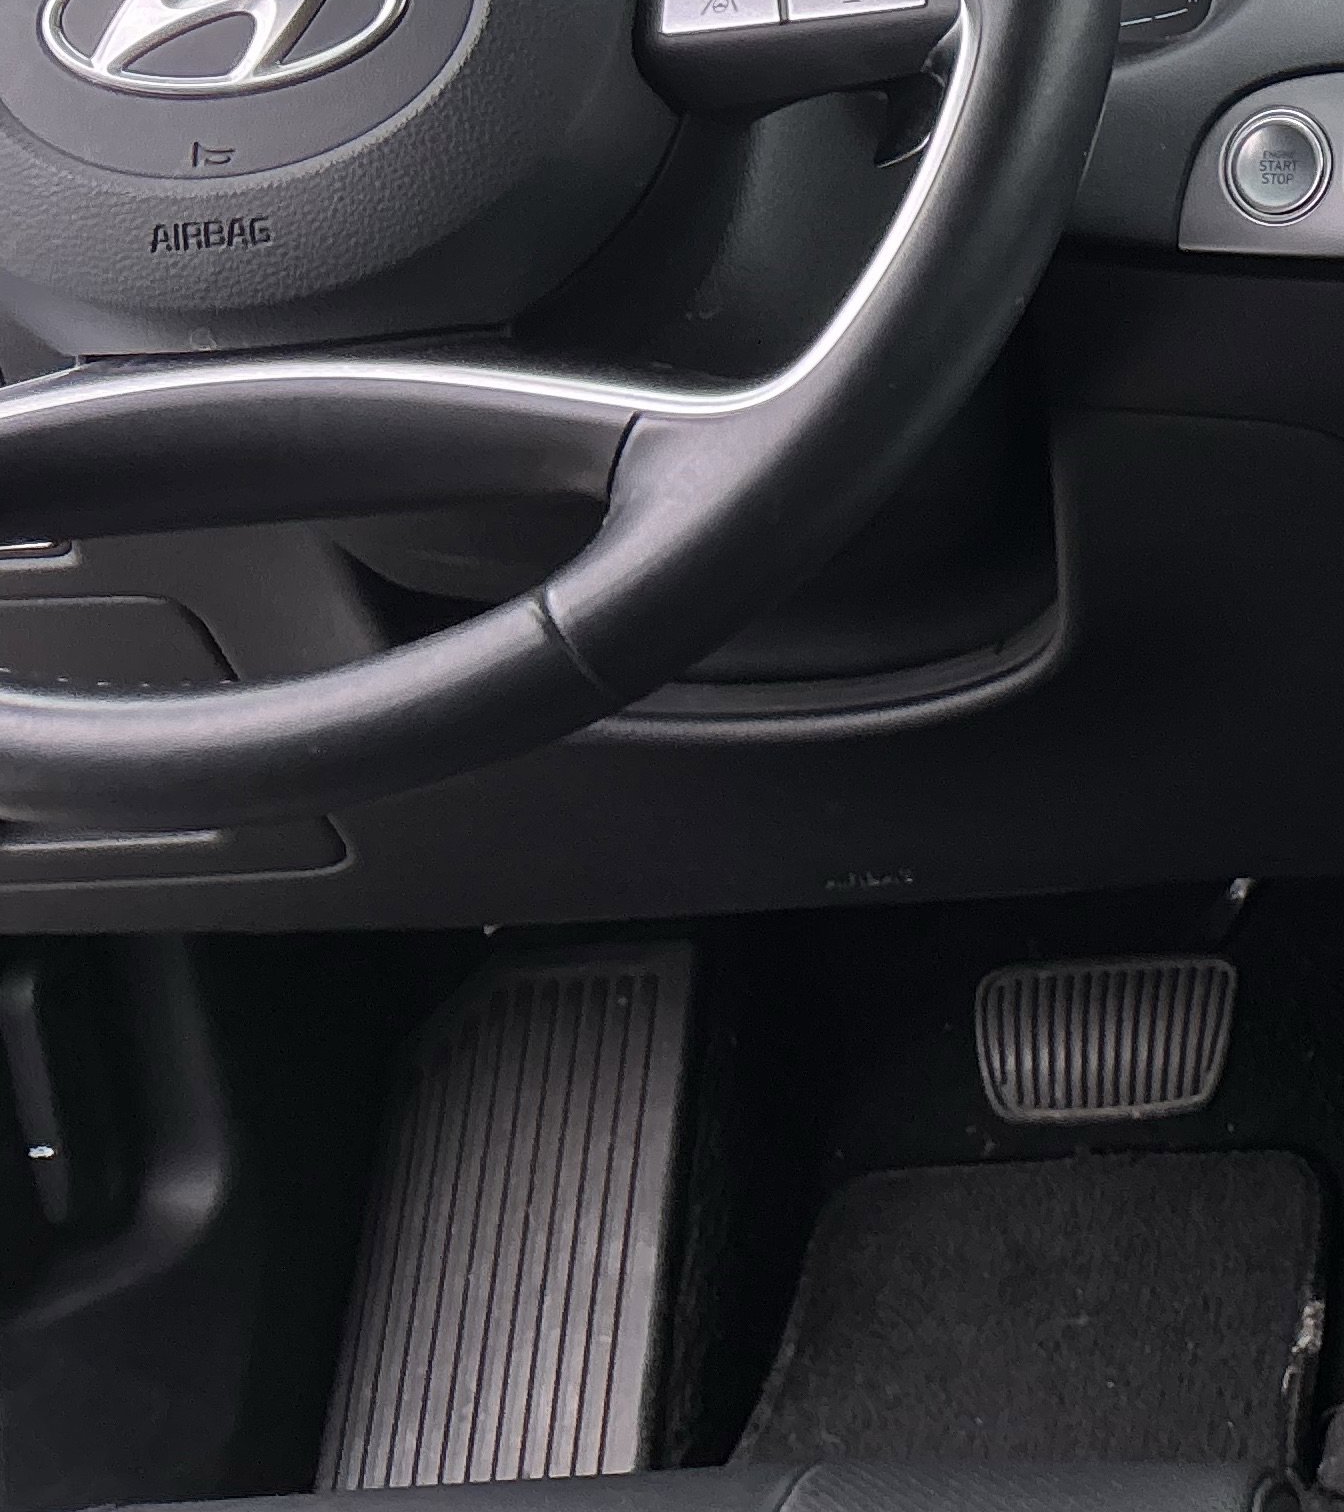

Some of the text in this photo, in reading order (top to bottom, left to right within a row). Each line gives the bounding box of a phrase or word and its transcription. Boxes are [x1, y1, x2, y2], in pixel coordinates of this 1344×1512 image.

[1259, 160, 1297, 172] START
[1261, 172, 1294, 185] STOP
[149, 216, 271, 252] AIRBAG
